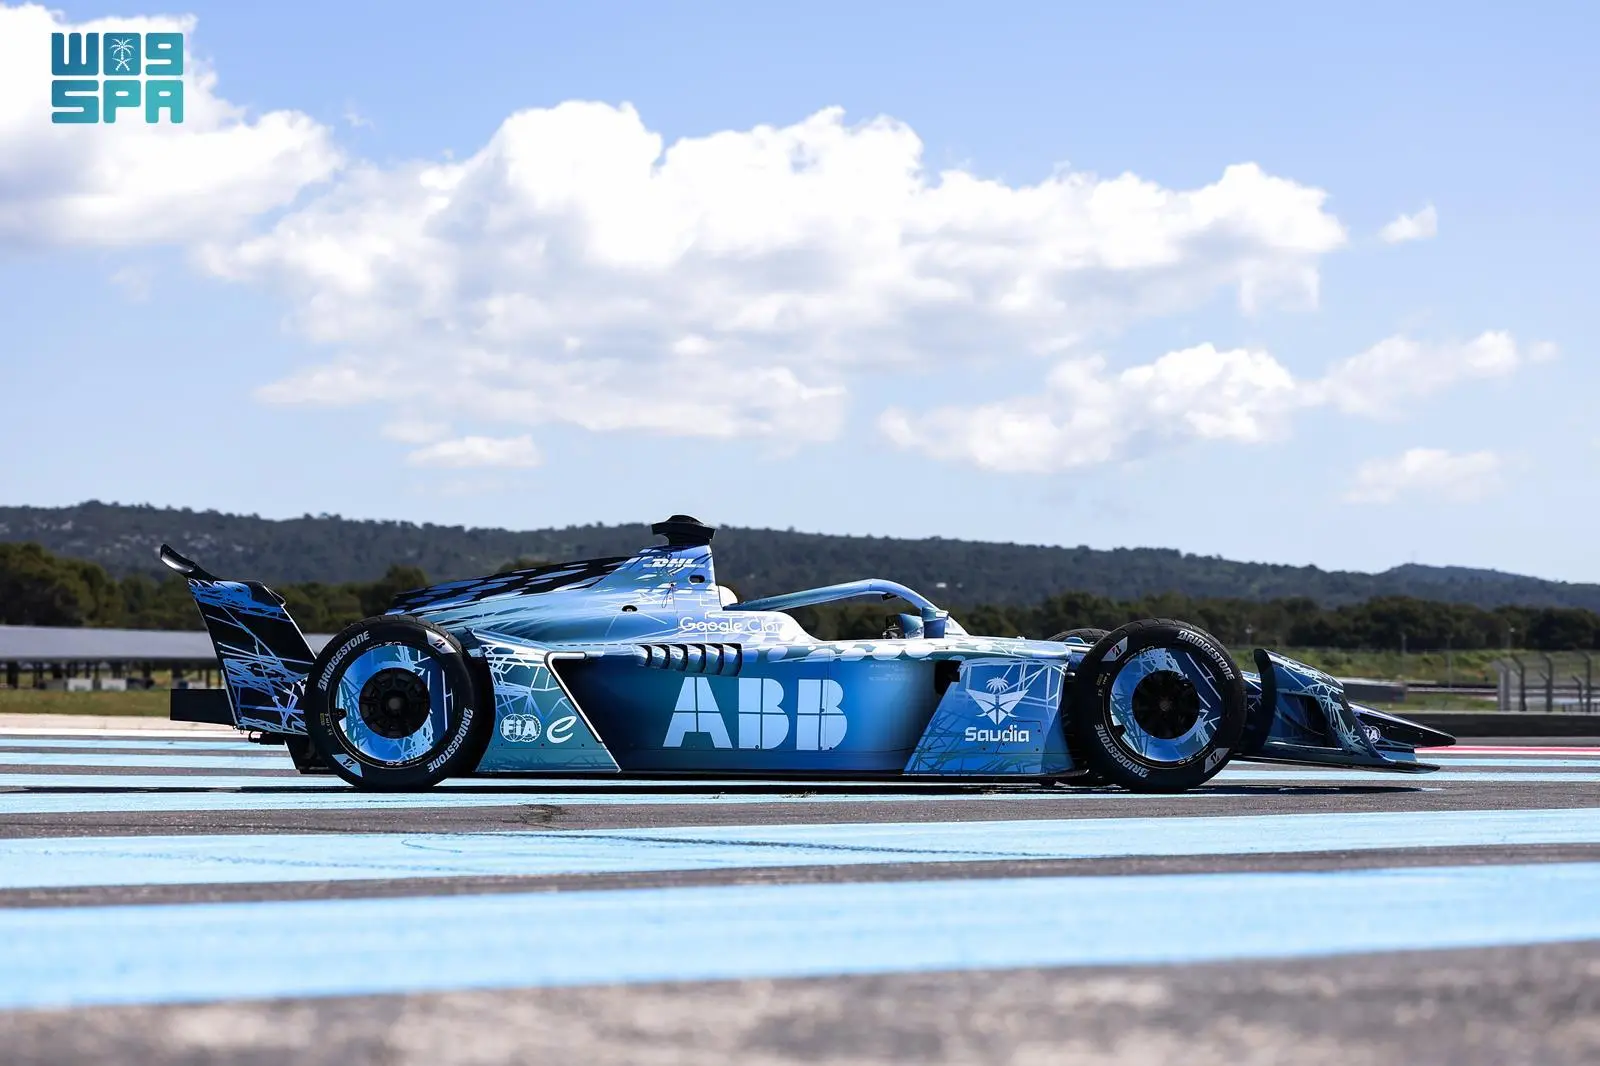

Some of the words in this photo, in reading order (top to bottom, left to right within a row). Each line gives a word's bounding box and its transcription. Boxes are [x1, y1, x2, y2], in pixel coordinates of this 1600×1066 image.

[651, 558, 697, 568] DHL
[680, 616, 742, 633] Google
[318, 630, 371, 692] BRIDGESTONE
[1177, 630, 1236, 681] BRIDGESTONE
[427, 708, 474, 773] BRIDGESTONE
[662, 677, 848, 751] ABB
[965, 725, 1030, 743] Saudia
[1094, 723, 1150, 779] BRIDGESTONE
